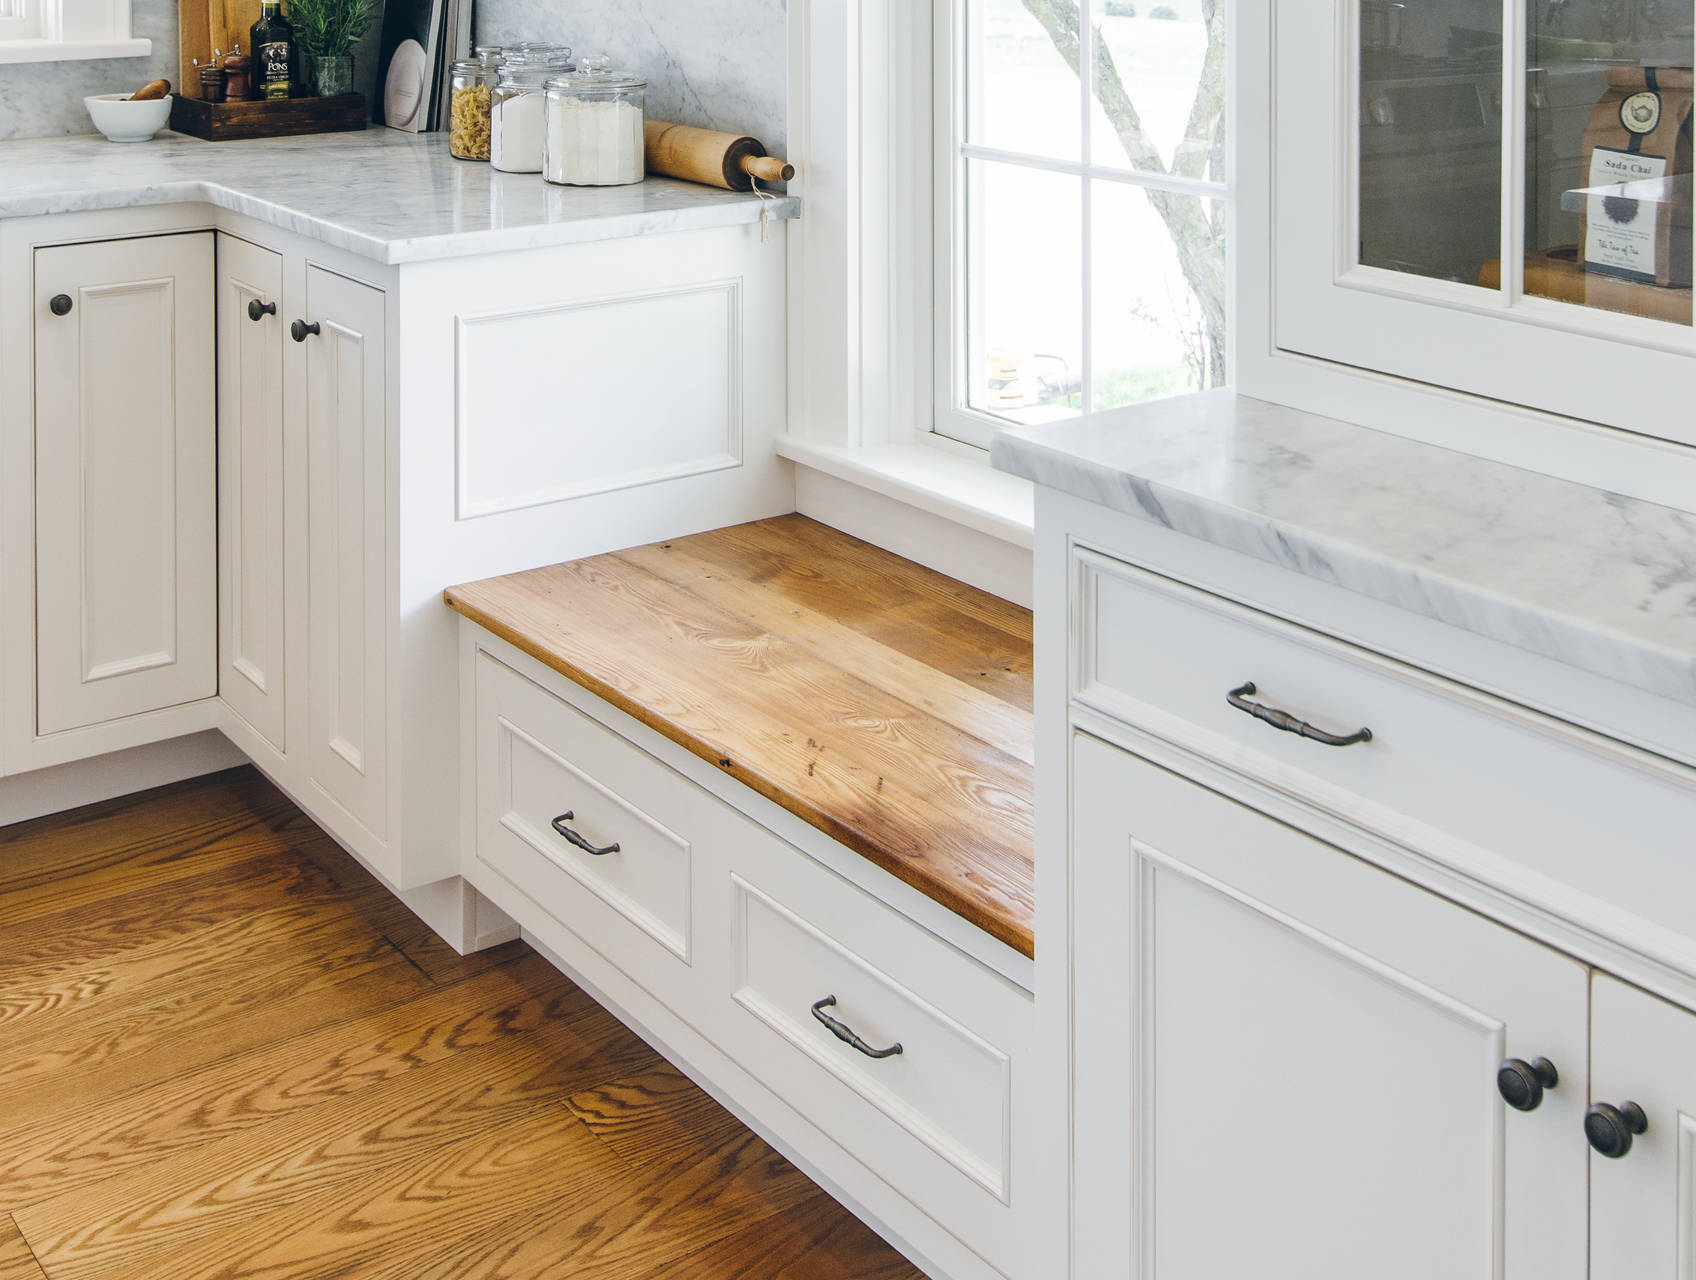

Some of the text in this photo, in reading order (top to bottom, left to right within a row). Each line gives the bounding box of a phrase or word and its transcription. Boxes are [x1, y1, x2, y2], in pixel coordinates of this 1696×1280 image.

[268, 62, 289, 71] PONS
[1603, 159, 1627, 171] Sada
[1630, 164, 1652, 175] Chai
